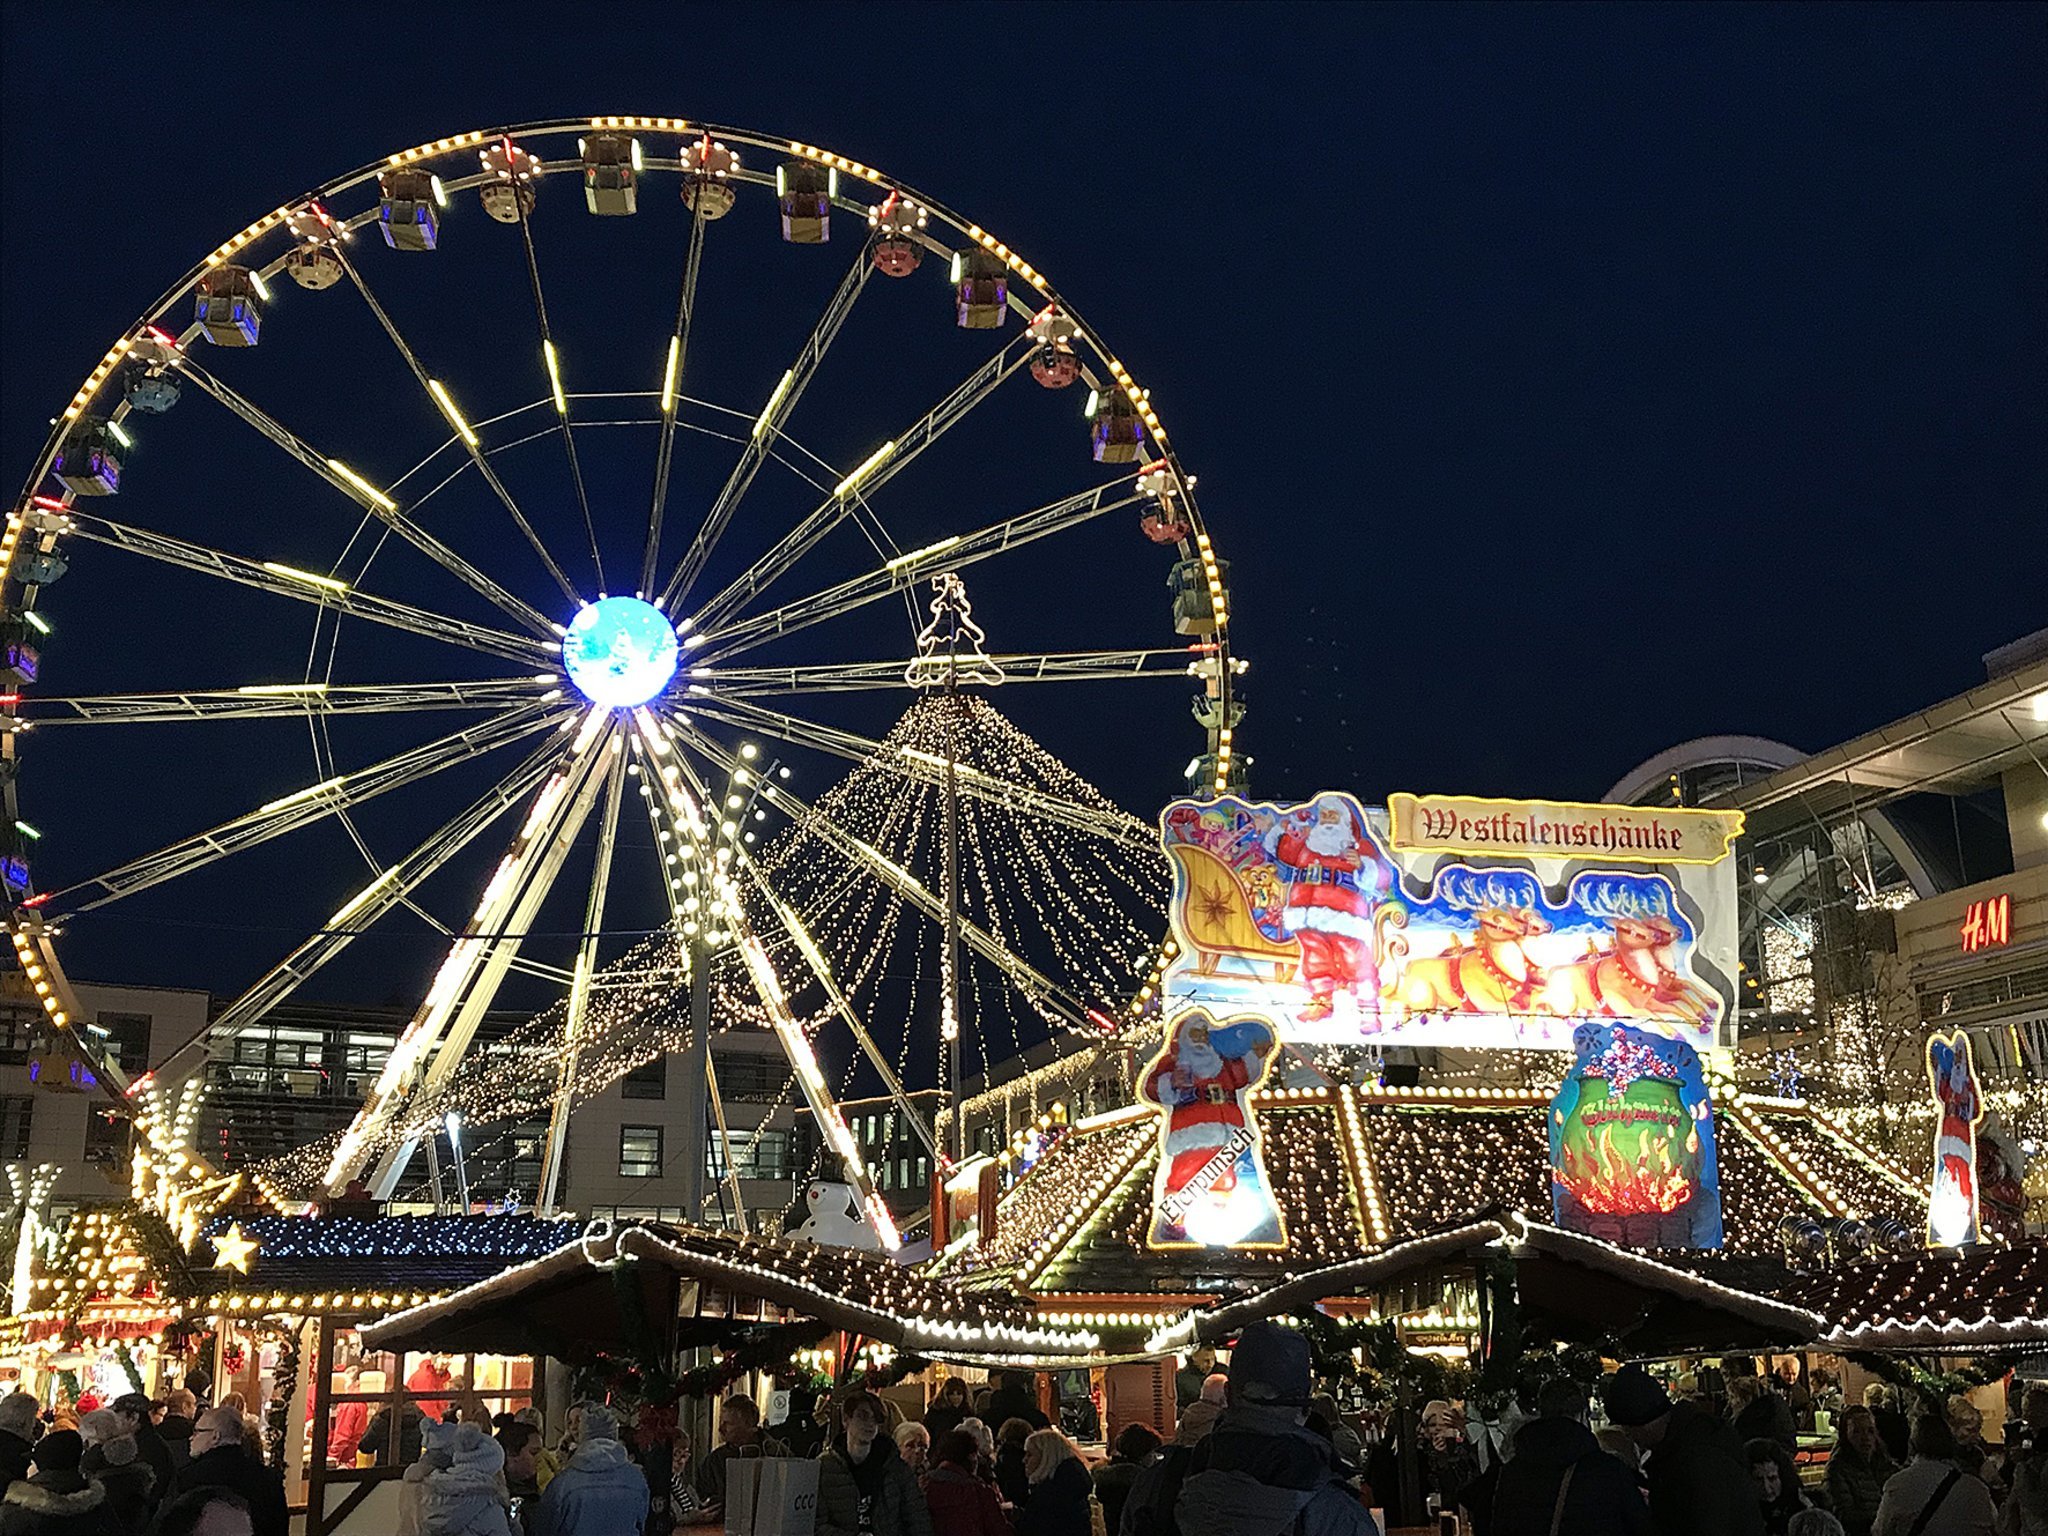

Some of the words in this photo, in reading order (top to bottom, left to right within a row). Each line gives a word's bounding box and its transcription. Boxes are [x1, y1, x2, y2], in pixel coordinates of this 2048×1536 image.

[1421, 807, 1683, 852] Westfalenschänke
[1960, 893, 2009, 953] H&M
[794, 1493, 815, 1511] CCC
